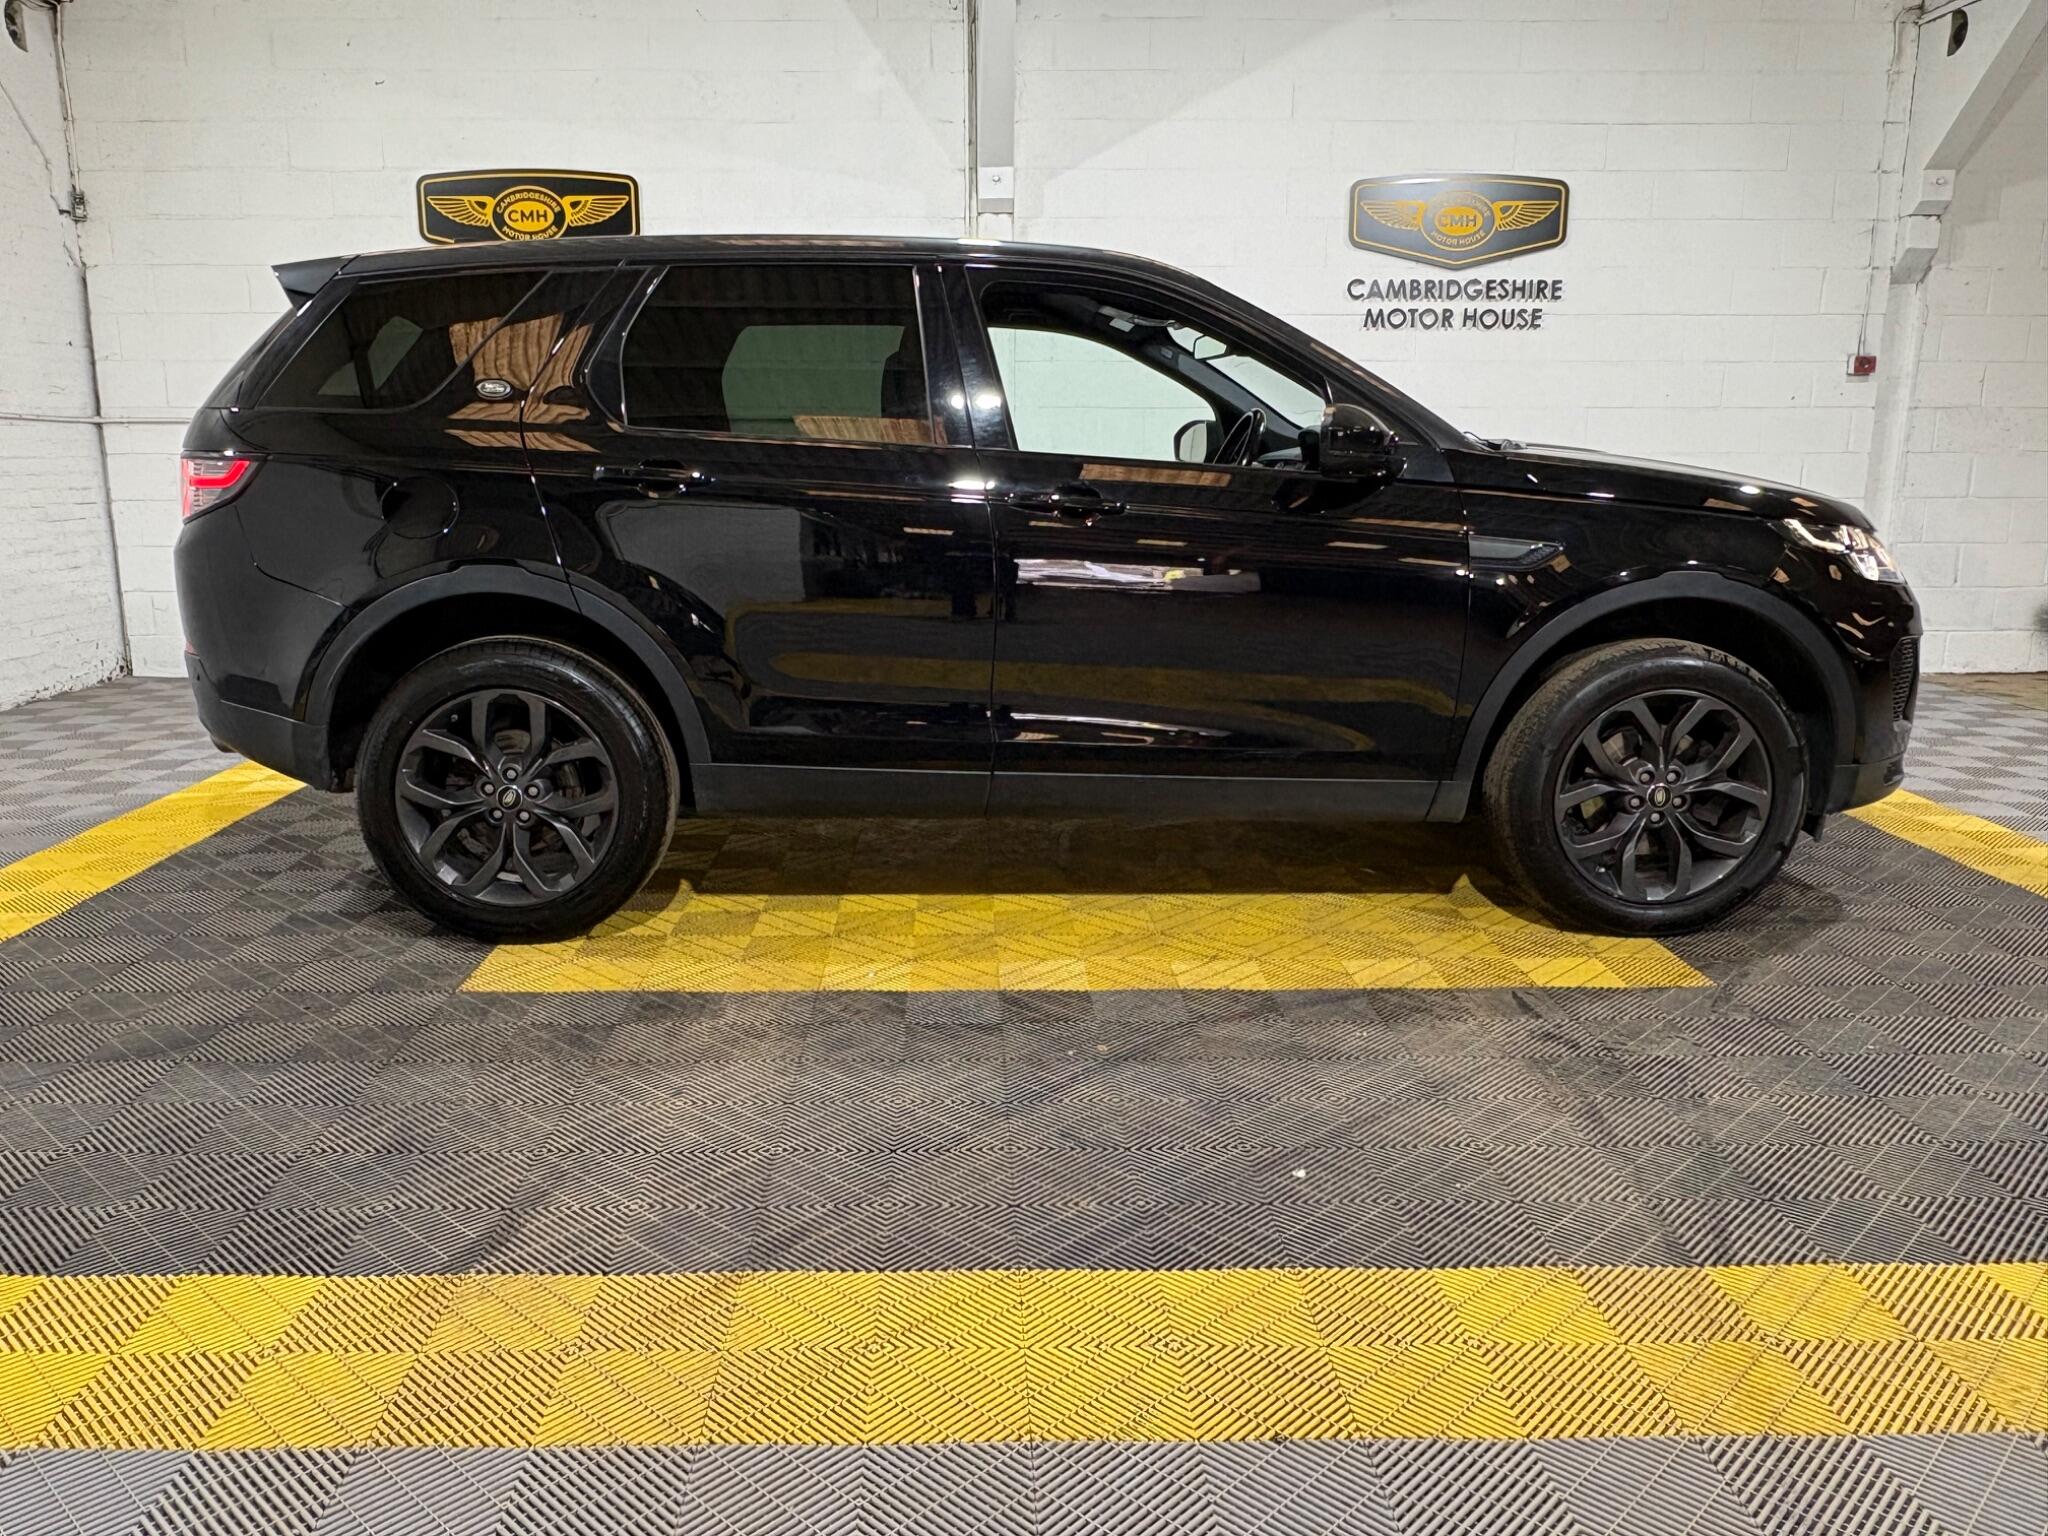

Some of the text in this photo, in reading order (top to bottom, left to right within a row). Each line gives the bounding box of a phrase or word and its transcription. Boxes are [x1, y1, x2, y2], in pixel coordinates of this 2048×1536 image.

[496, 192, 561, 214] CAMBRIDGESHIRE
[508, 209, 548, 223] CMH
[1438, 215, 1477, 227] CMH
[502, 226, 531, 240] MOTOR
[1430, 230, 1486, 245] MOTOR HOUSE
[1347, 278, 1563, 301] CAMBRIDGESHIRE
[1363, 308, 1544, 329] MOTOR HOUSE
